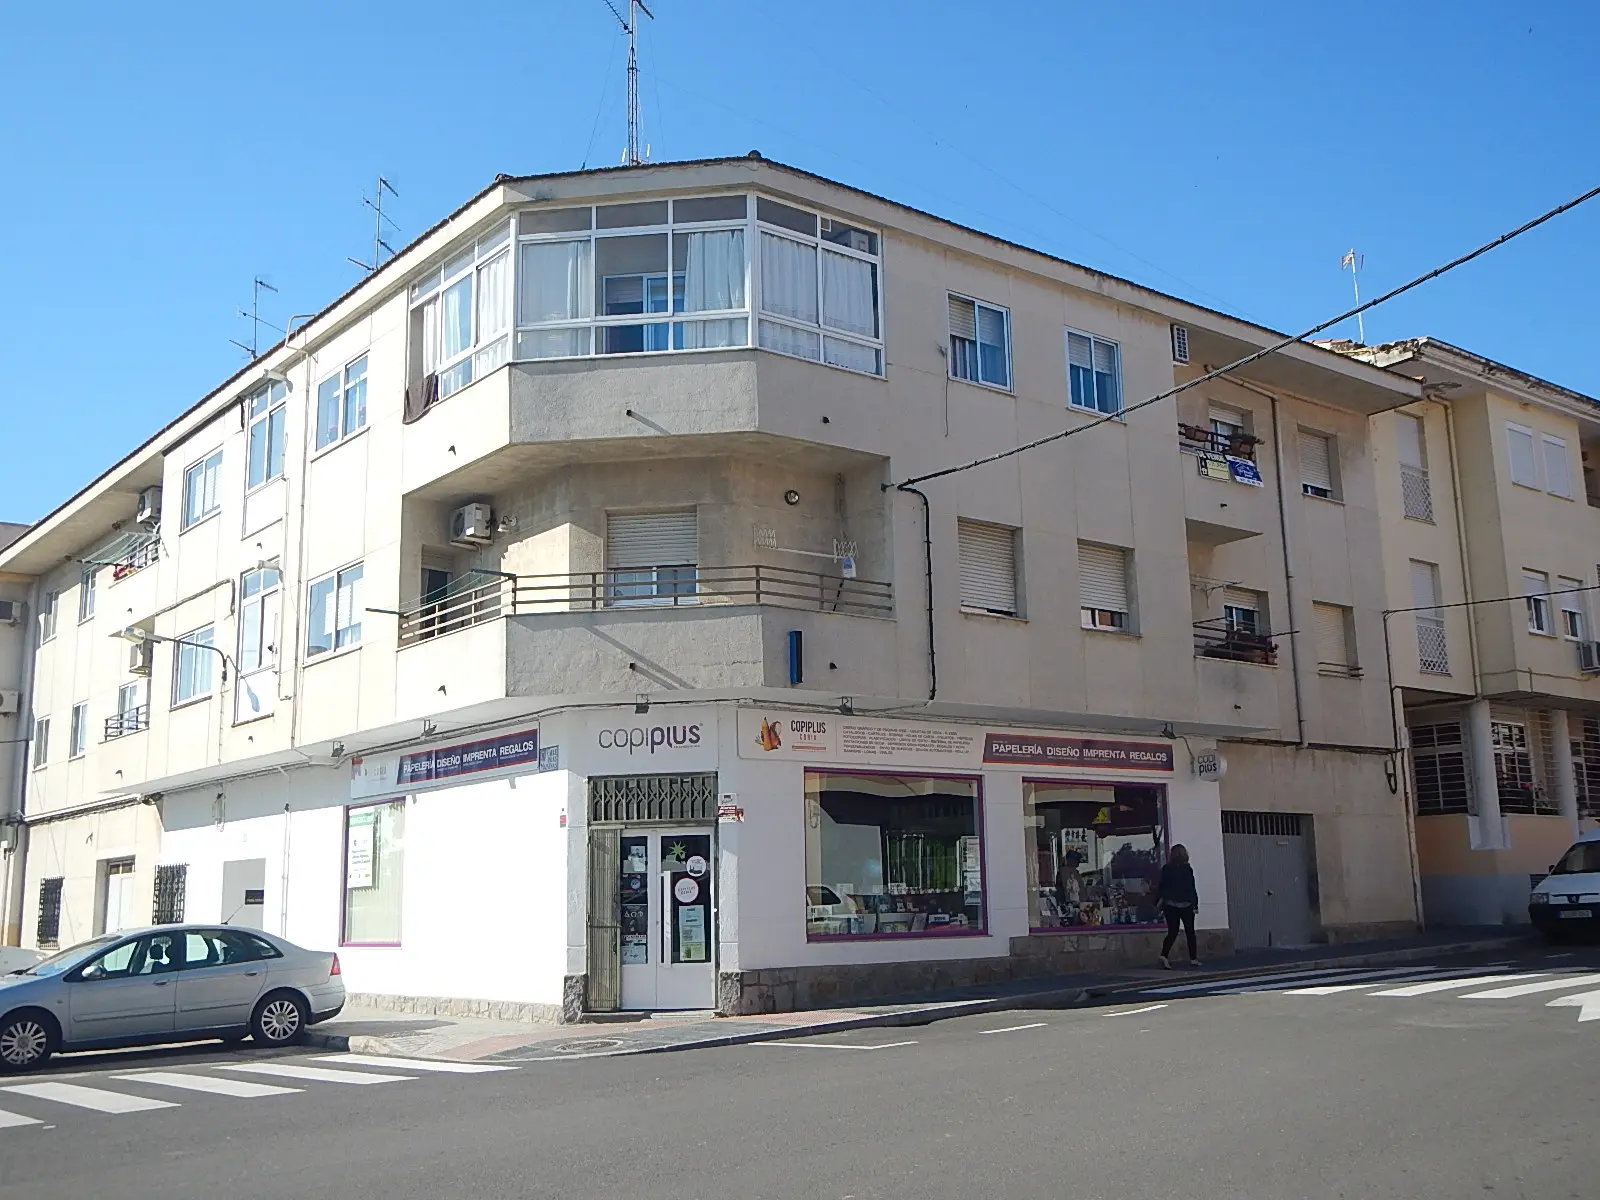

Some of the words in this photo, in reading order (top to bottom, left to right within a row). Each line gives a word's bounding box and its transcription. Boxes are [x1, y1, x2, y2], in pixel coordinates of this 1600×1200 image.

[790, 720, 826, 734] COPIPLUS
[598, 724, 701, 755] copiplus
[403, 758, 436, 774] PAPELERÍA
[436, 754, 461, 768] DISEÑO
[462, 748, 497, 763] IMPRENTA
[499, 740, 534, 756] REGALOS
[992, 742, 1043, 755] PAPELERÍA
[1046, 745, 1080, 757] DISEÑO
[1083, 748, 1126, 759] IMPRENTA
[1129, 750, 1168, 762] REGALOS
[1199, 763, 1217, 777] plus
